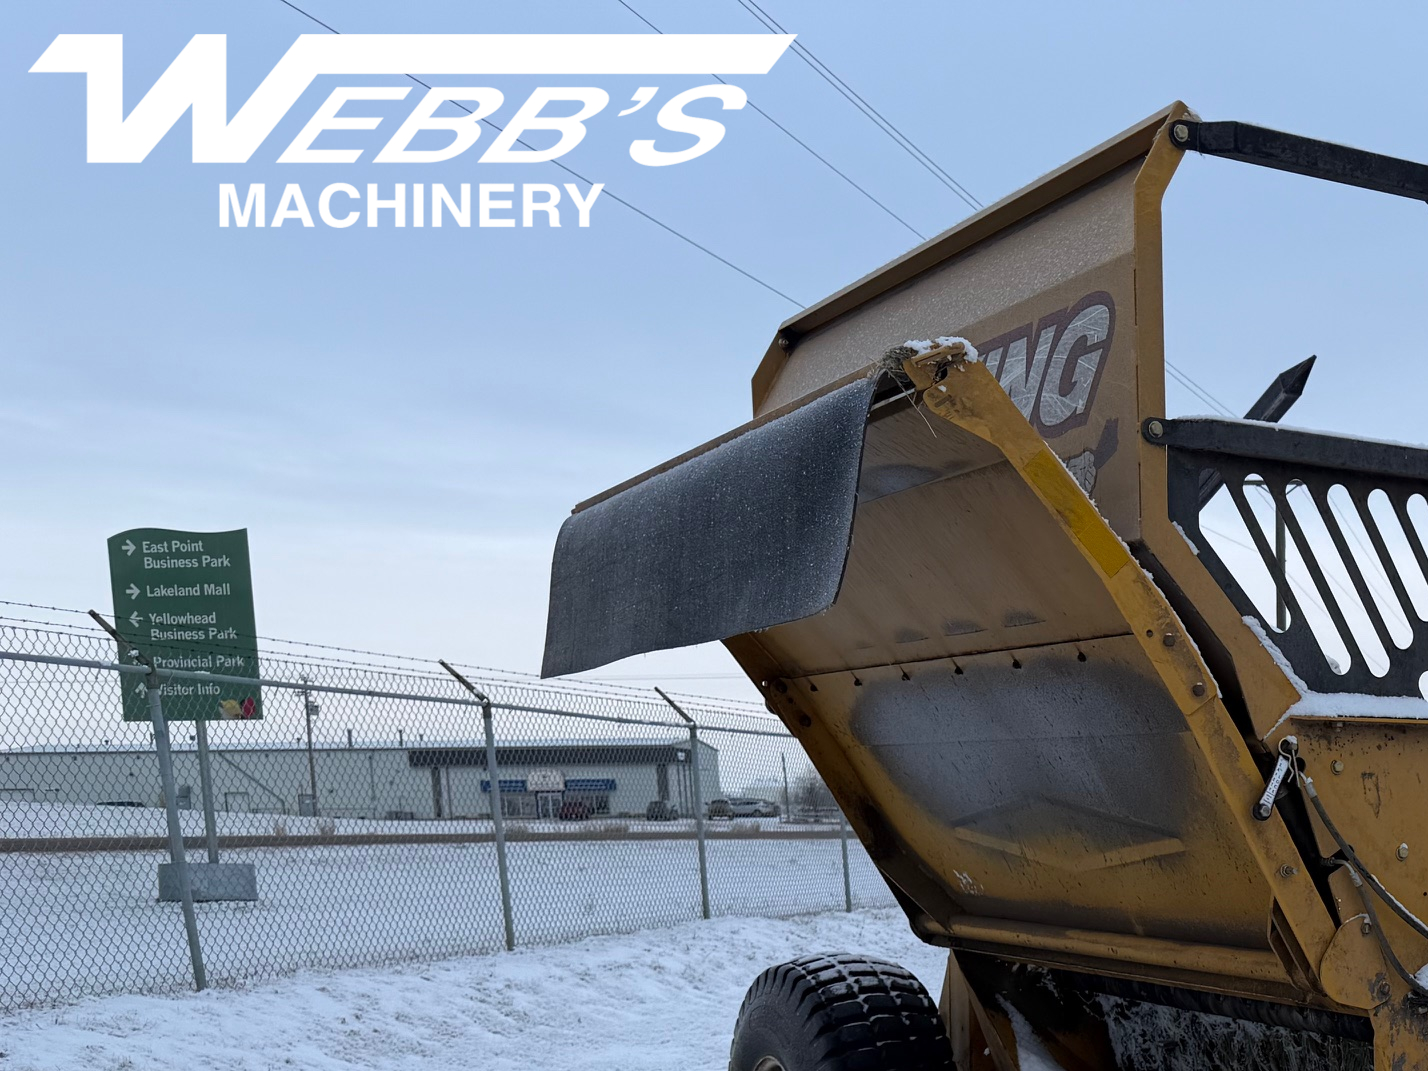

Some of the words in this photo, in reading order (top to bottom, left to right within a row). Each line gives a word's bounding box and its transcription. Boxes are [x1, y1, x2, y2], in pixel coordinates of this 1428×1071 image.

[142, 541, 169, 553] East
[171, 540, 204, 552] Point
[144, 556, 199, 569] Business
[202, 555, 231, 567] Park
[146, 584, 200, 597] Lakeland
[204, 583, 231, 595] Mall
[148, 611, 217, 625] Yellowhead
[151, 628, 205, 640] Business
[209, 627, 238, 640] Park
[153, 655, 212, 668] Provincial
[216, 655, 245, 667] Park
[198, 682, 220, 695] Info
